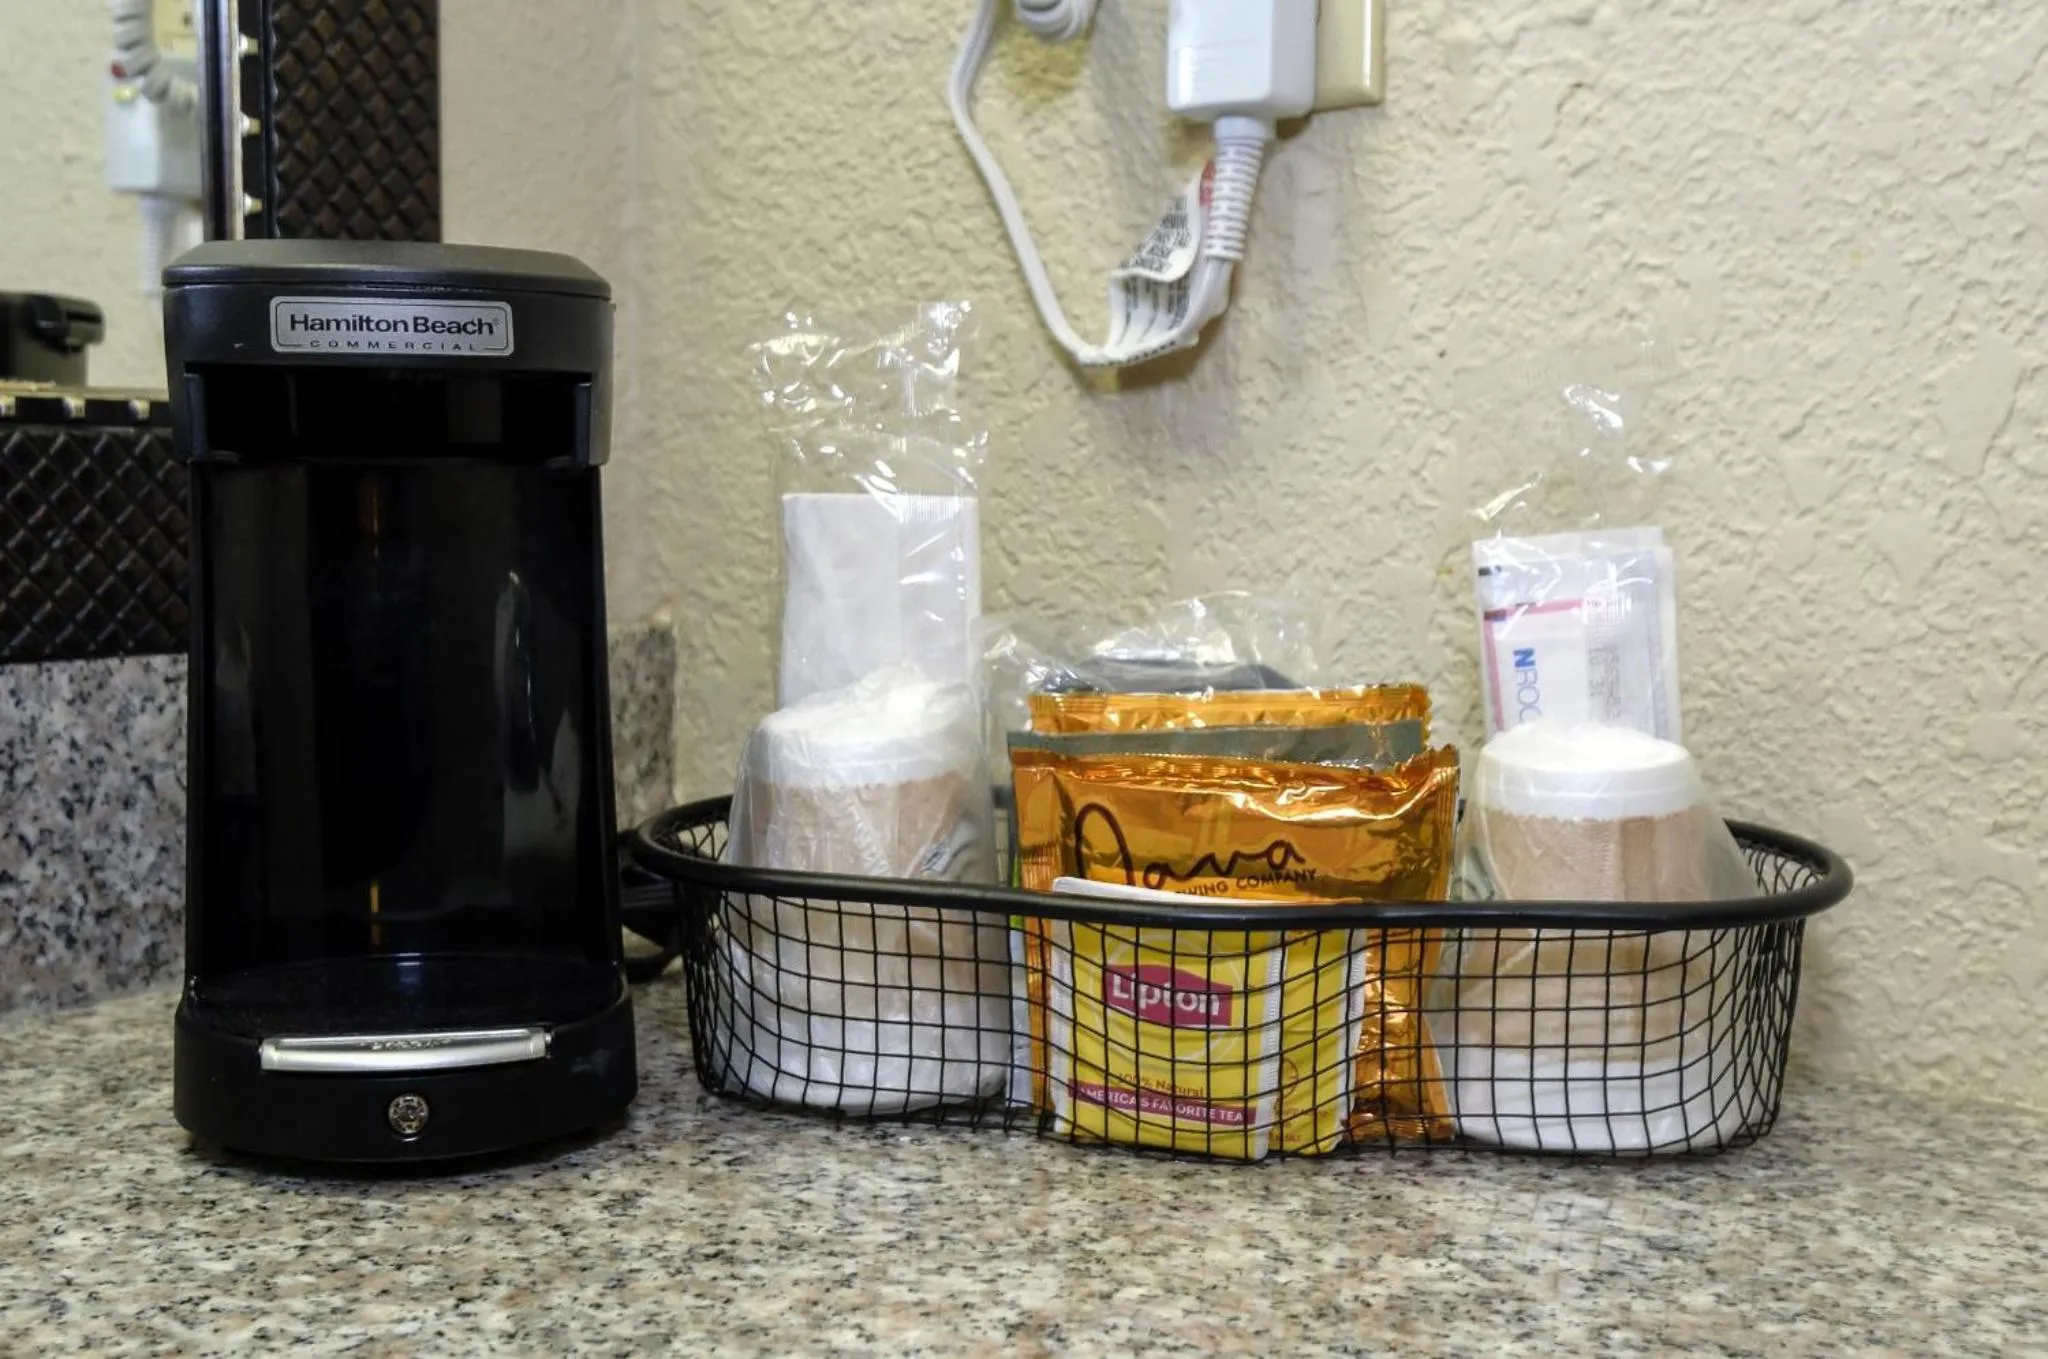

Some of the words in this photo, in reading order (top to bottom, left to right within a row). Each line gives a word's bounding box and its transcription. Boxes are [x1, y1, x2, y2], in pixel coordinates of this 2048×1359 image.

[290, 314, 409, 333] Hamilton
[412, 316, 494, 335] Beach
[309, 340, 476, 351] COMMERCIAL
[1236, 868, 1317, 890] COMPANY
[1112, 972, 1220, 1016] Lipton
[1079, 1086, 1150, 1108] MEICAS
[1219, 1109, 1244, 1122] TEA
